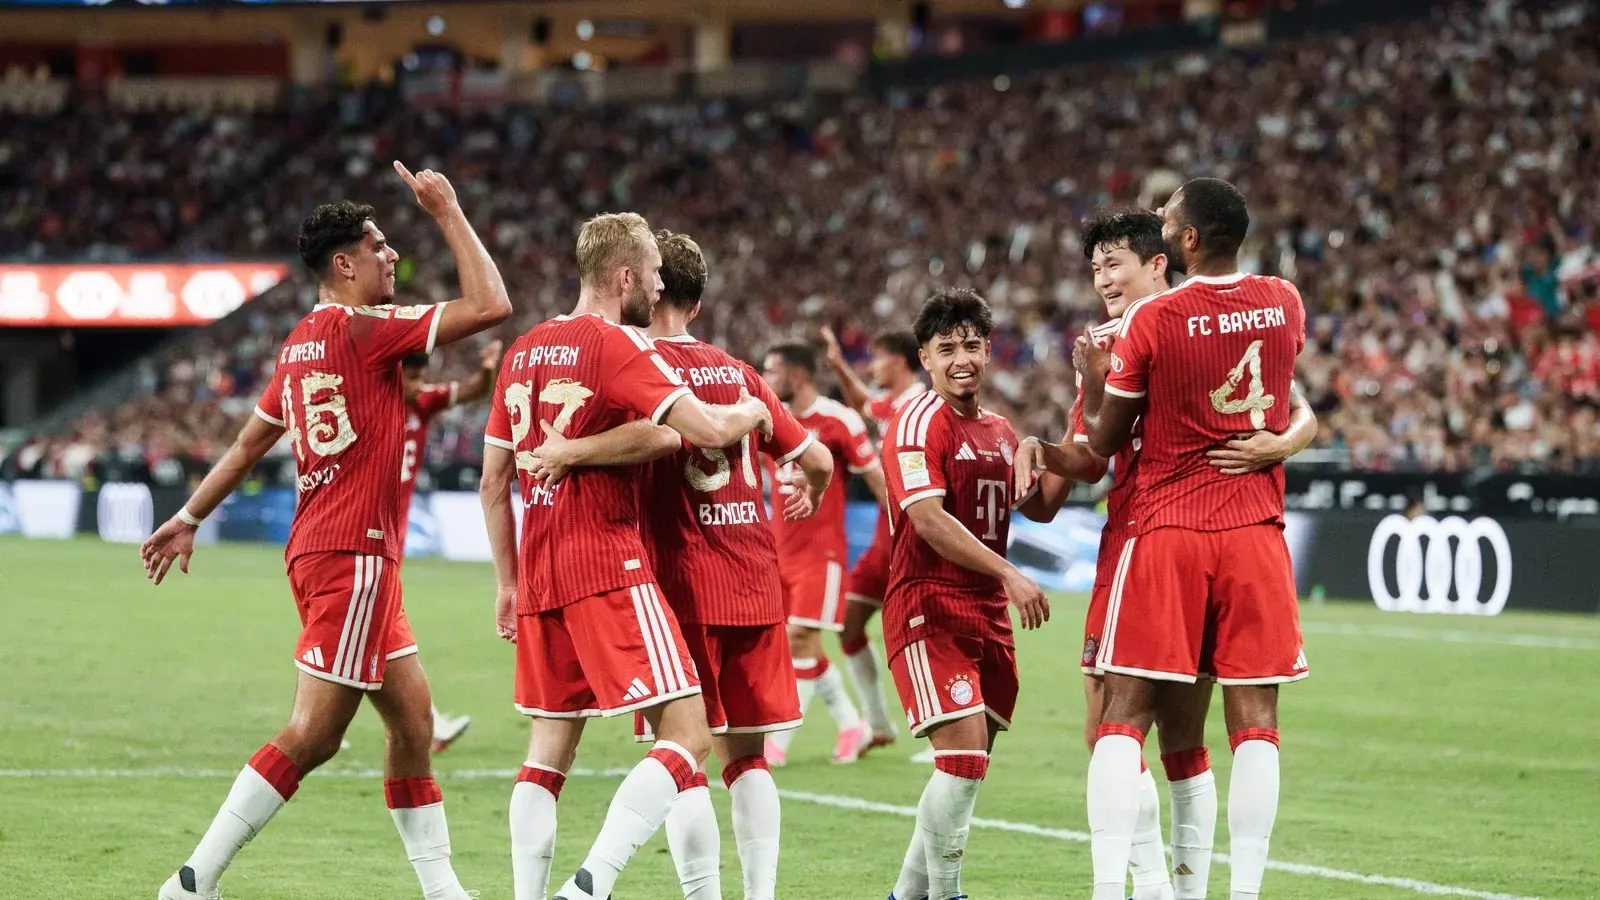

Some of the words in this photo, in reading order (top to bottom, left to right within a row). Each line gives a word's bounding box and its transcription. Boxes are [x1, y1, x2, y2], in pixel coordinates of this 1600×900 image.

[1187, 315, 1212, 337] FC
[1217, 305, 1286, 334] BAYERN
[511, 350, 527, 372] FC
[528, 345, 580, 368] BAYERN
[1208, 339, 1275, 430] 4
[699, 501, 760, 526] BINDER
